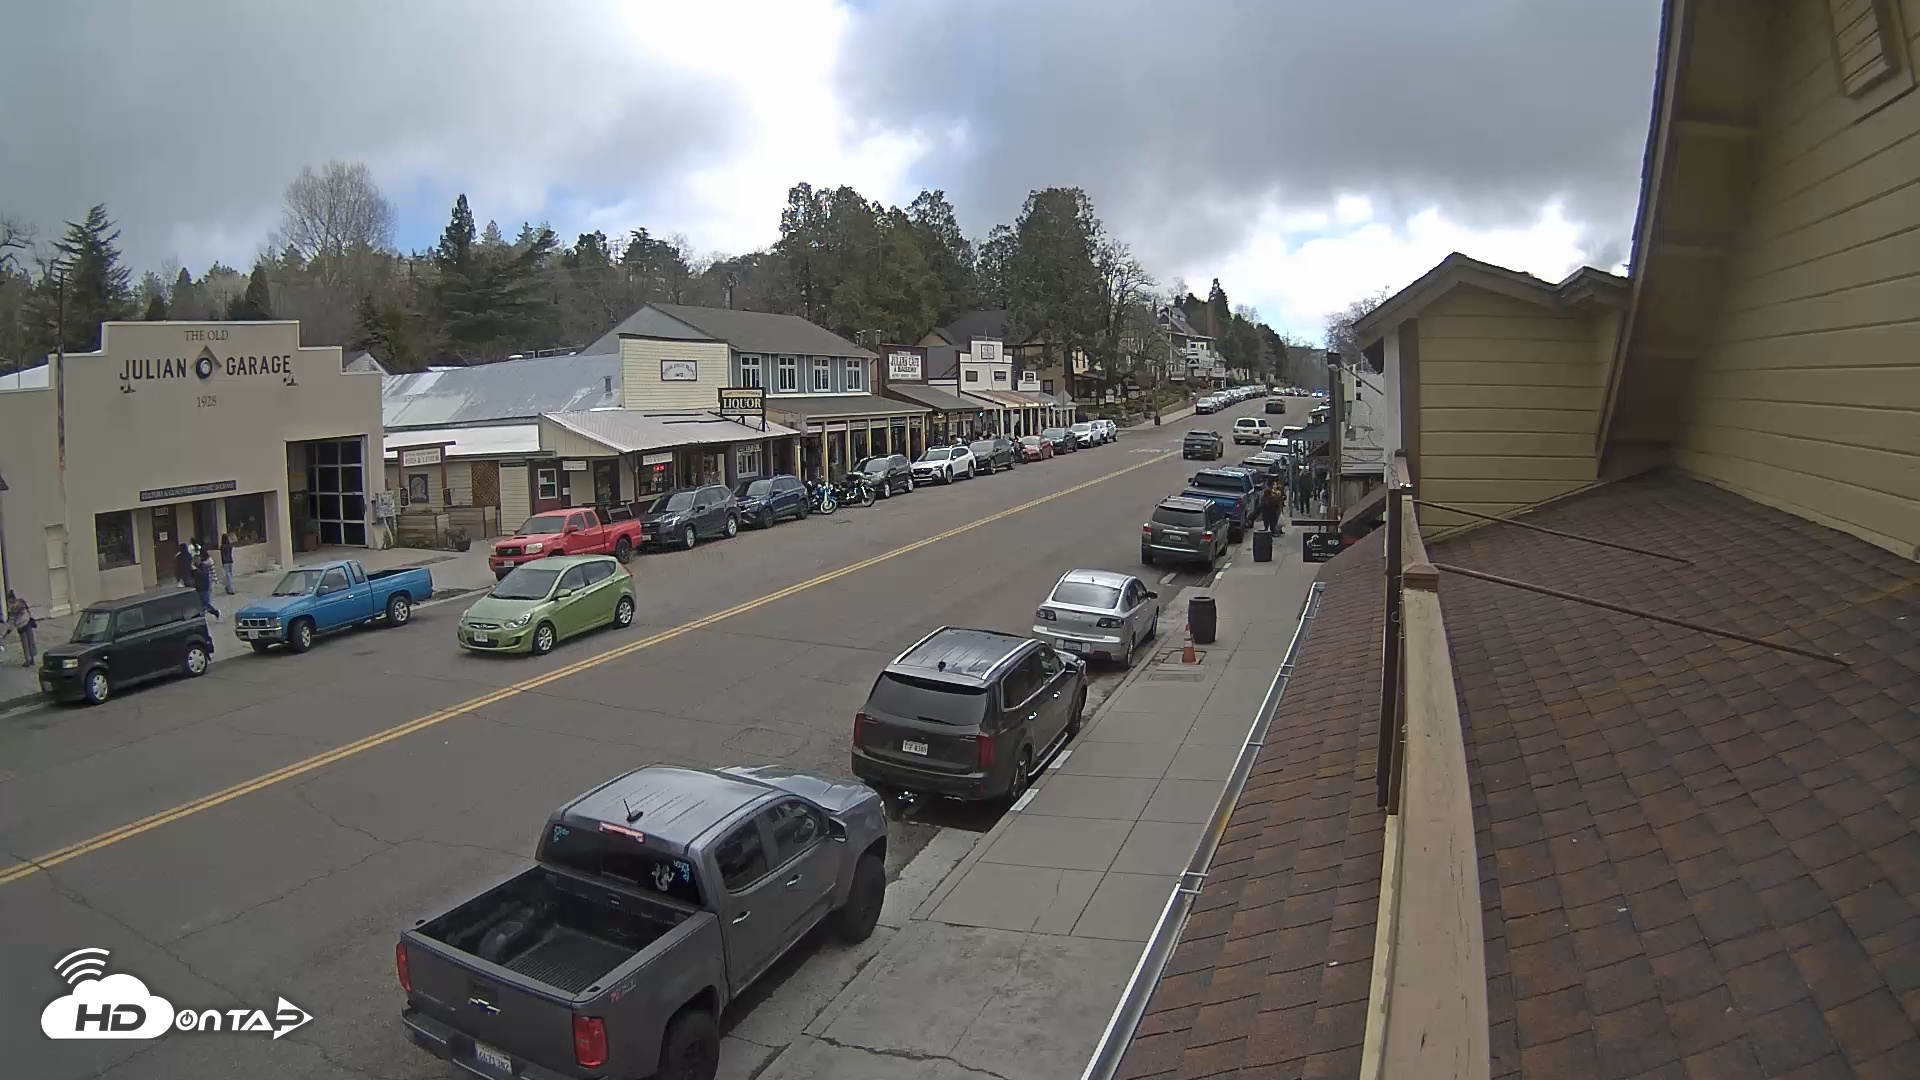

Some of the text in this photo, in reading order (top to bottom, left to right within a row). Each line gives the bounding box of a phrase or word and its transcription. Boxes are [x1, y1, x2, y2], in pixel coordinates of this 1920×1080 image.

[184, 330, 228, 341] THE OLD
[119, 355, 291, 380] JULIAN GARAGE
[196, 395, 217, 407] 1928
[723, 398, 762, 409] LIQUOR
